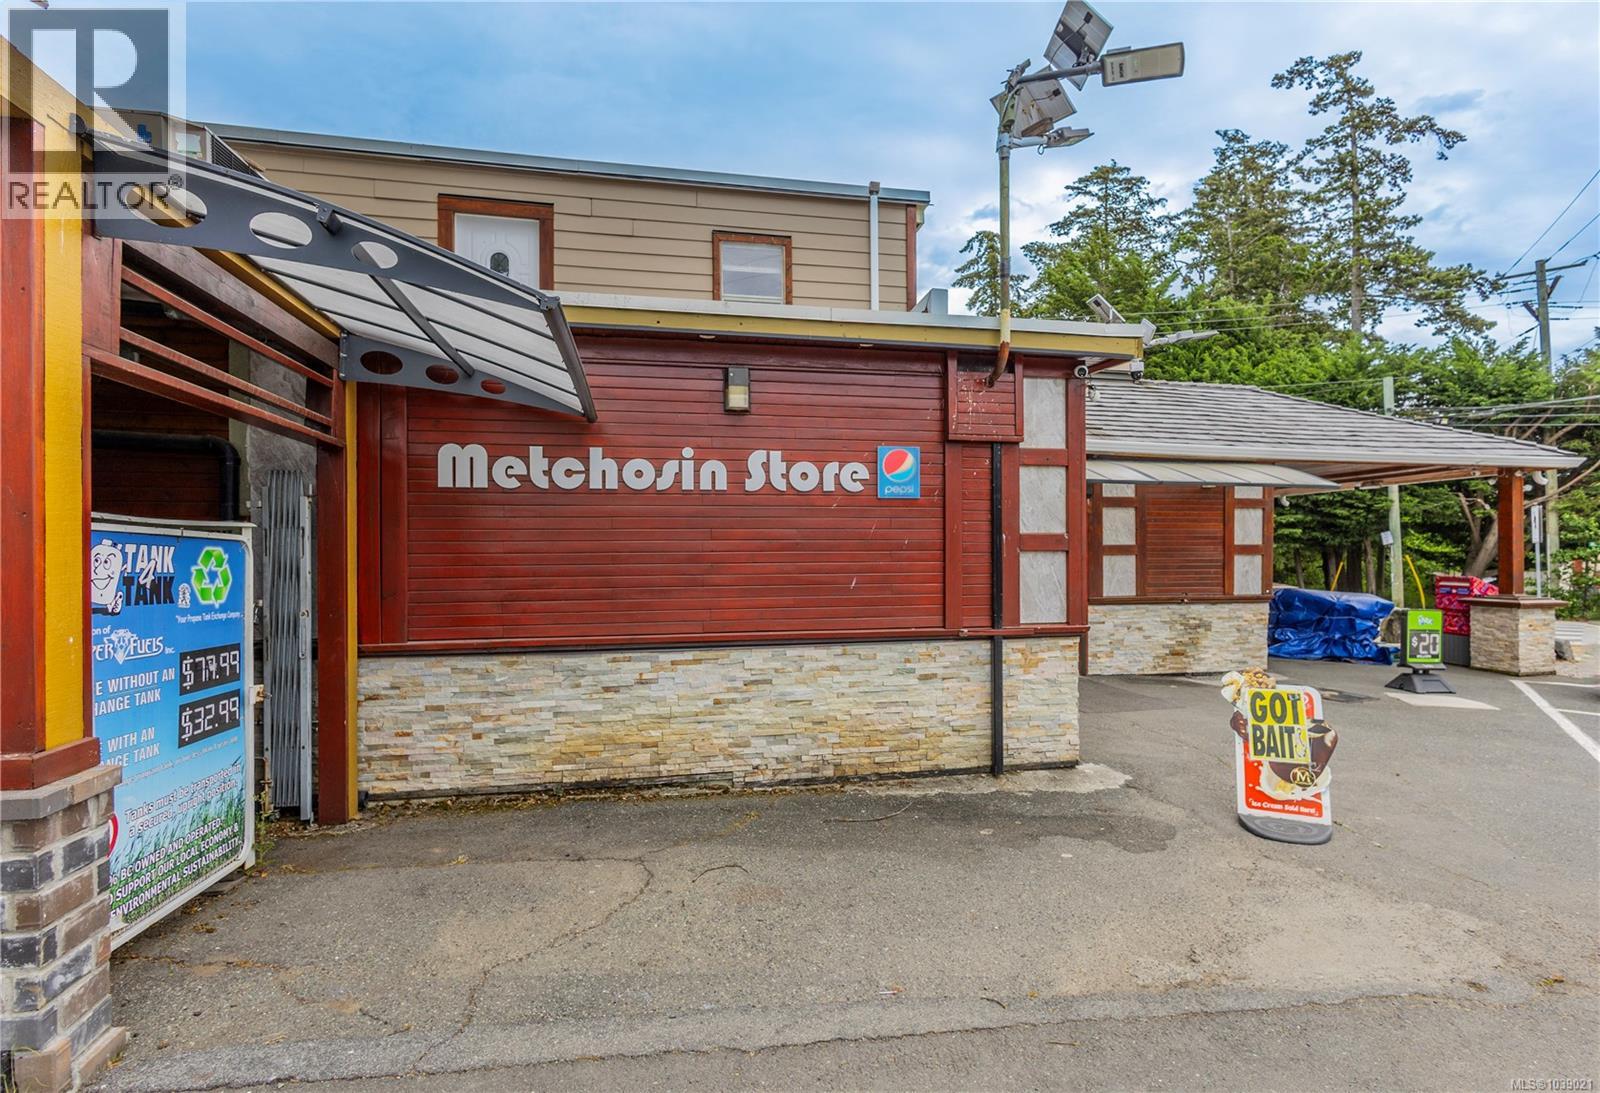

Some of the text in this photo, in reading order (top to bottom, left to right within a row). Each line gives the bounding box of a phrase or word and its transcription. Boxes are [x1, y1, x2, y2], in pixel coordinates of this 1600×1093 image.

[437, 442, 870, 493] Metchosin Store
[885, 485, 914, 496] pepsi
[125, 543, 175, 574] TANK
[122, 575, 175, 607] TANK
[107, 670, 159, 693] WITHOUT
[162, 667, 175, 682] AN
[134, 688, 161, 706] TANK
[1250, 690, 1301, 725] GOT
[181, 696, 239, 742] $32.99
[107, 731, 137, 753] WITH
[141, 726, 155, 742] AN
[133, 742, 160, 763] TANK
[1252, 724, 1295, 759] BAIT
[125, 801, 154, 823] Tanks
[155, 789, 177, 811] must
[178, 786, 189, 800] be
[191, 767, 232, 793] transported
[129, 825, 136, 839] a
[116, 868, 157, 902] SUPPORT
[158, 858, 175, 876] OUR
[176, 845, 200, 867] LOCAL
[201, 826, 233, 852] ECONOMY
[121, 864, 133, 881] BC
[135, 847, 166, 873] OWNED
[168, 837, 184, 857] AND
[110, 871, 181, 917] ENVIRONMENTAL
